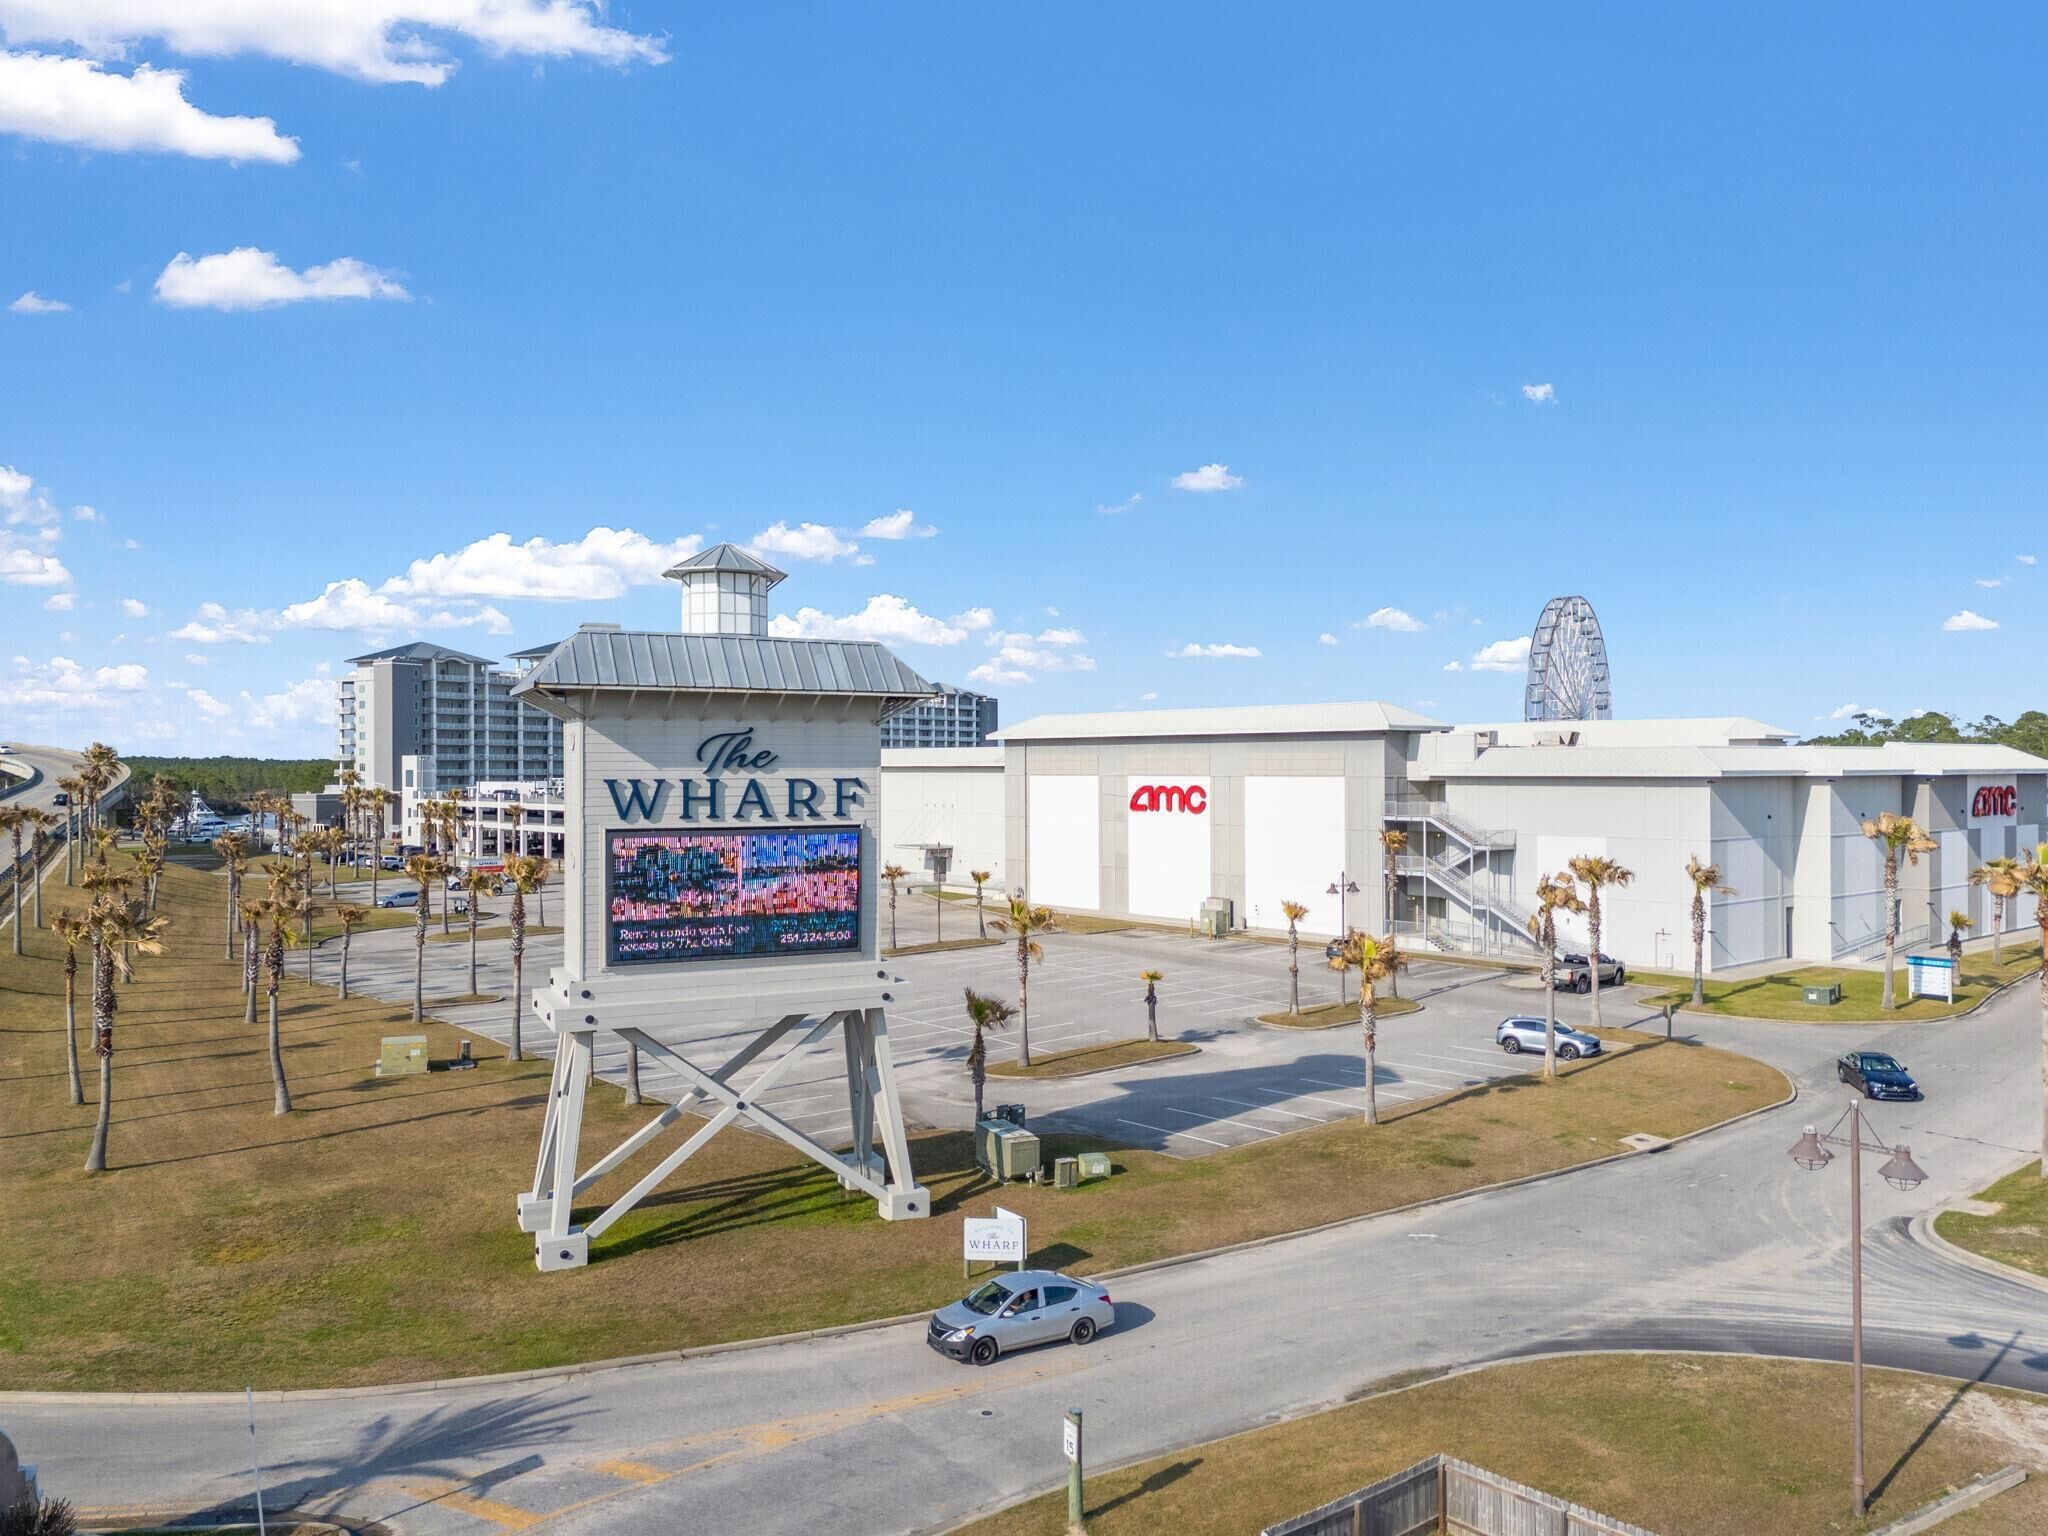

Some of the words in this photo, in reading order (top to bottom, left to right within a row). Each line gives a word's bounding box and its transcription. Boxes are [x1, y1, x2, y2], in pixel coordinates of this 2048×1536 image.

[697, 727, 779, 775] The
[603, 777, 864, 820] WHARF
[660, 926, 697, 937] condo
[969, 1240, 1019, 1250] WHARF
[1066, 1439, 1074, 1455] 15
